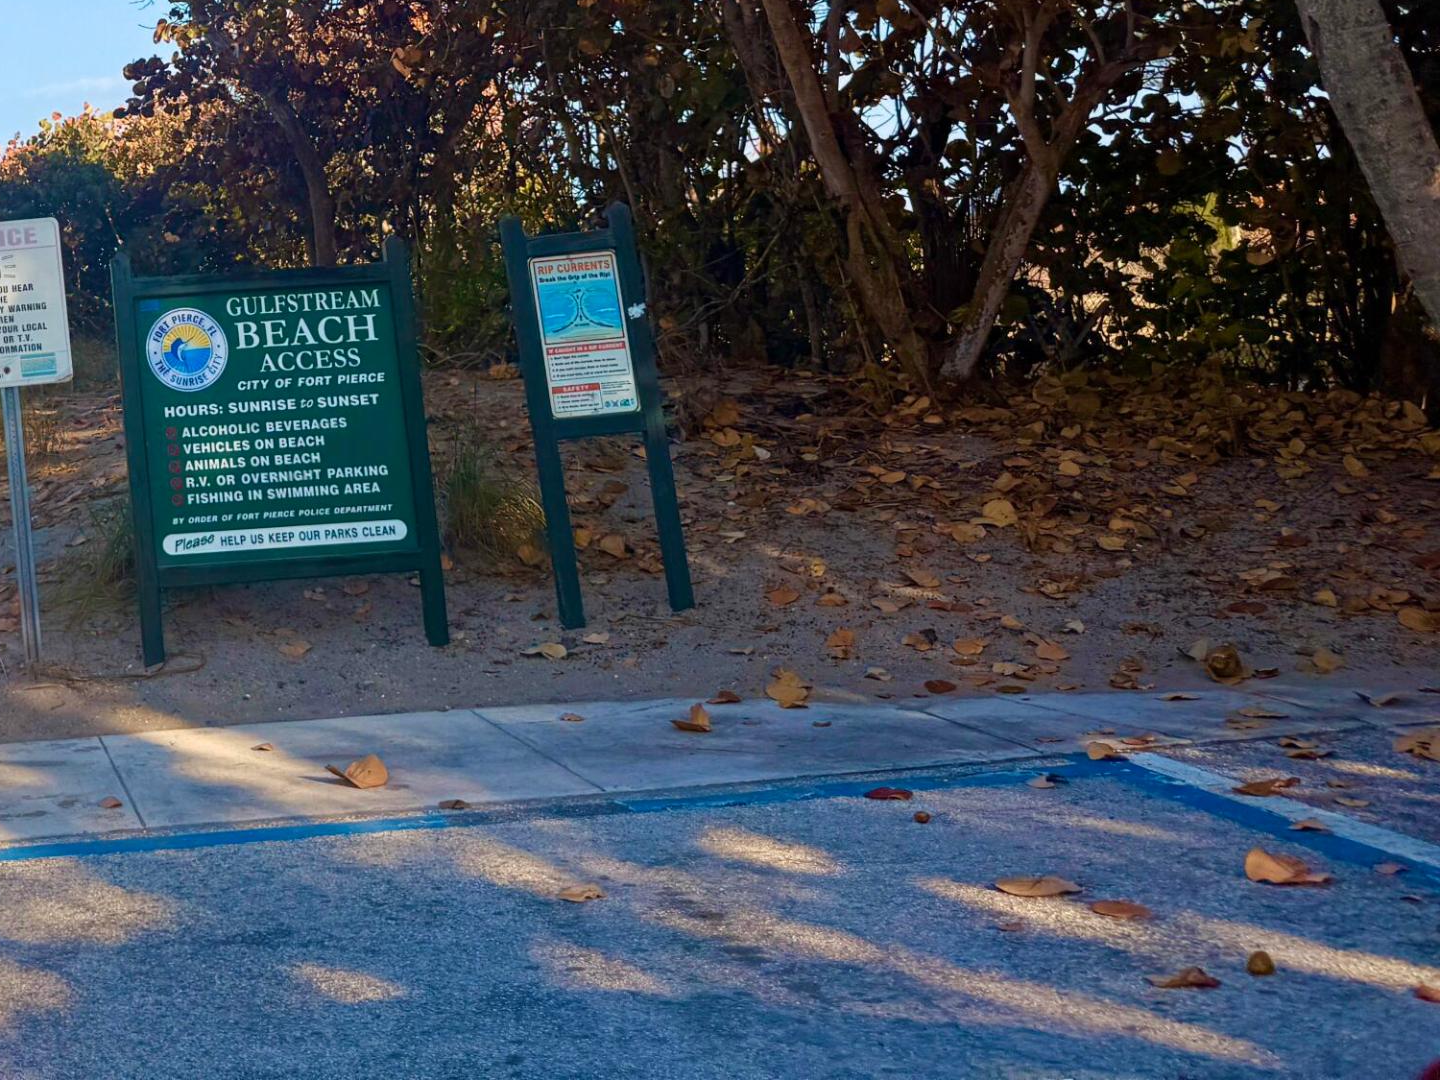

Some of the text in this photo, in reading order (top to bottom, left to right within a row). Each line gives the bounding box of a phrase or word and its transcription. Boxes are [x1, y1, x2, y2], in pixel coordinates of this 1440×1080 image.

[537, 260, 610, 275] RIP CURRENTS
[11, 283, 34, 293] HEAR
[8, 302, 48, 313] WARNING
[226, 289, 381, 317] GULFSTREAM
[22, 322, 48, 332] LOCAL
[152, 321, 170, 343] FORT
[207, 325, 218, 337] FL
[234, 313, 379, 350] BEACH
[3, 335, 15, 344] OR
[18, 334, 34, 343] T.V.
[155, 353, 223, 387] THE SUNRISE CITY
[260, 347, 361, 373] ACCESS
[237, 372, 386, 391] CITY OF FORT PIERCE
[563, 384, 589, 392] SAFETY
[164, 394, 380, 418] HOURS: SUNRISE to SUNSET
[181, 417, 348, 438] ALCOHOLIC BEVERAGES
[183, 435, 325, 455] VEHICLES ON BEACH
[185, 452, 321, 472] ANIMALS ON BEACH
[186, 464, 389, 488] R.V. OR OVERNIGHT PARKING
[187, 481, 381, 505] FISHING IN SWIMMING AREA
[172, 503, 394, 525] BY ORDER OF FORT PIERCE POLICE DEPARTMENT
[174, 525, 396, 552] Please HELP US KEEP OUR PARKS CLEAN
